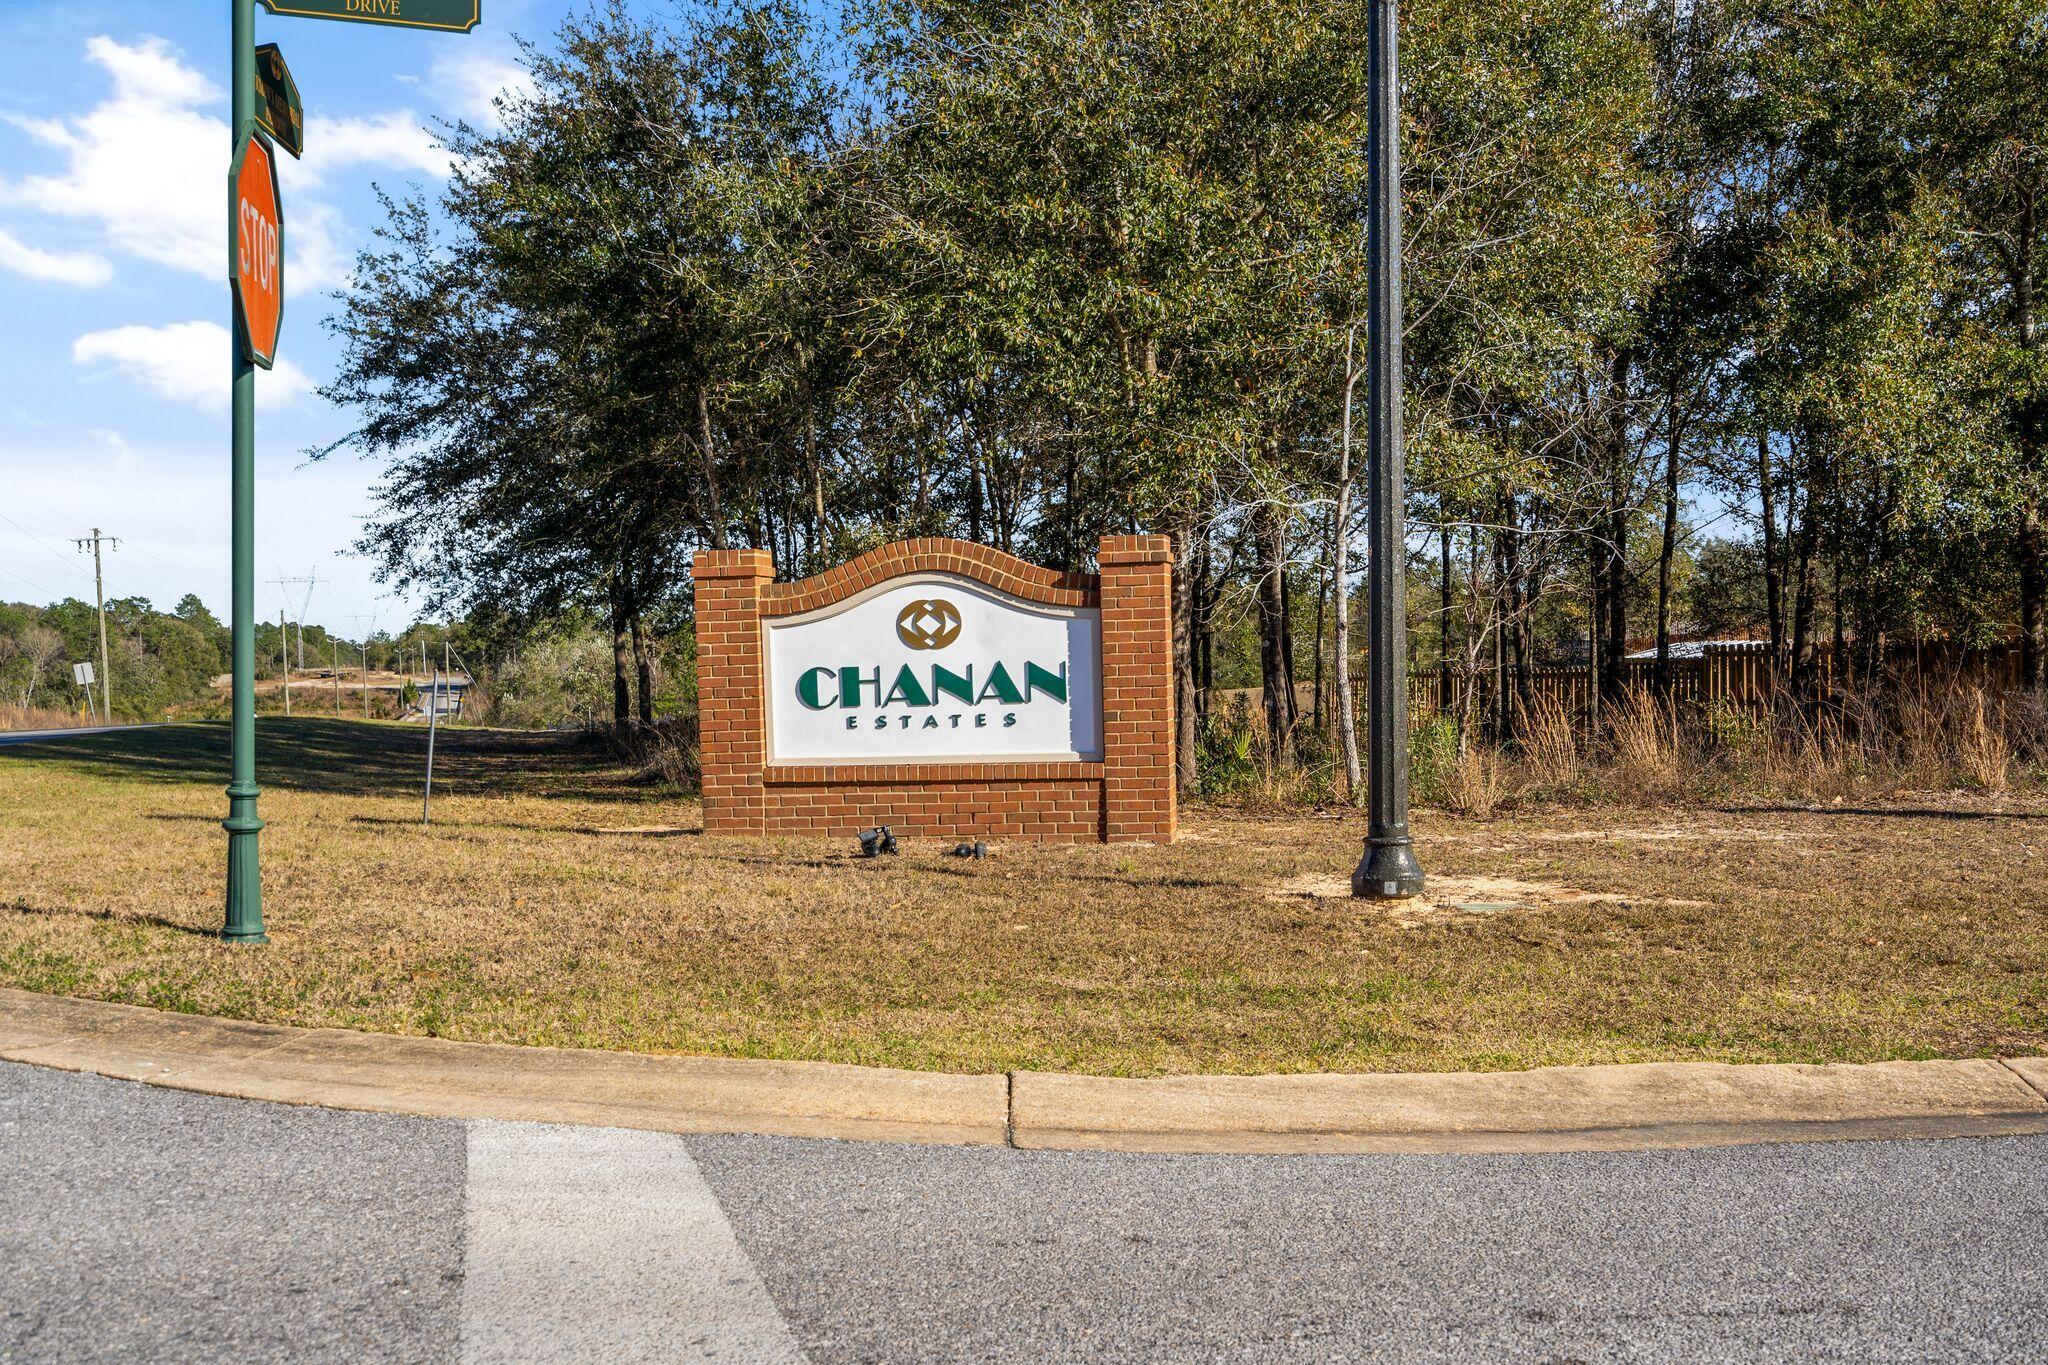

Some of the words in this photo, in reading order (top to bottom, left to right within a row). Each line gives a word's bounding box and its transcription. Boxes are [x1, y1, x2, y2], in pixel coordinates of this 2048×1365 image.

[346, 0, 400, 15] DRIVE
[241, 197, 276, 294] STOP
[795, 660, 1068, 711] CHANAN
[846, 712, 1017, 731] ESTATES
